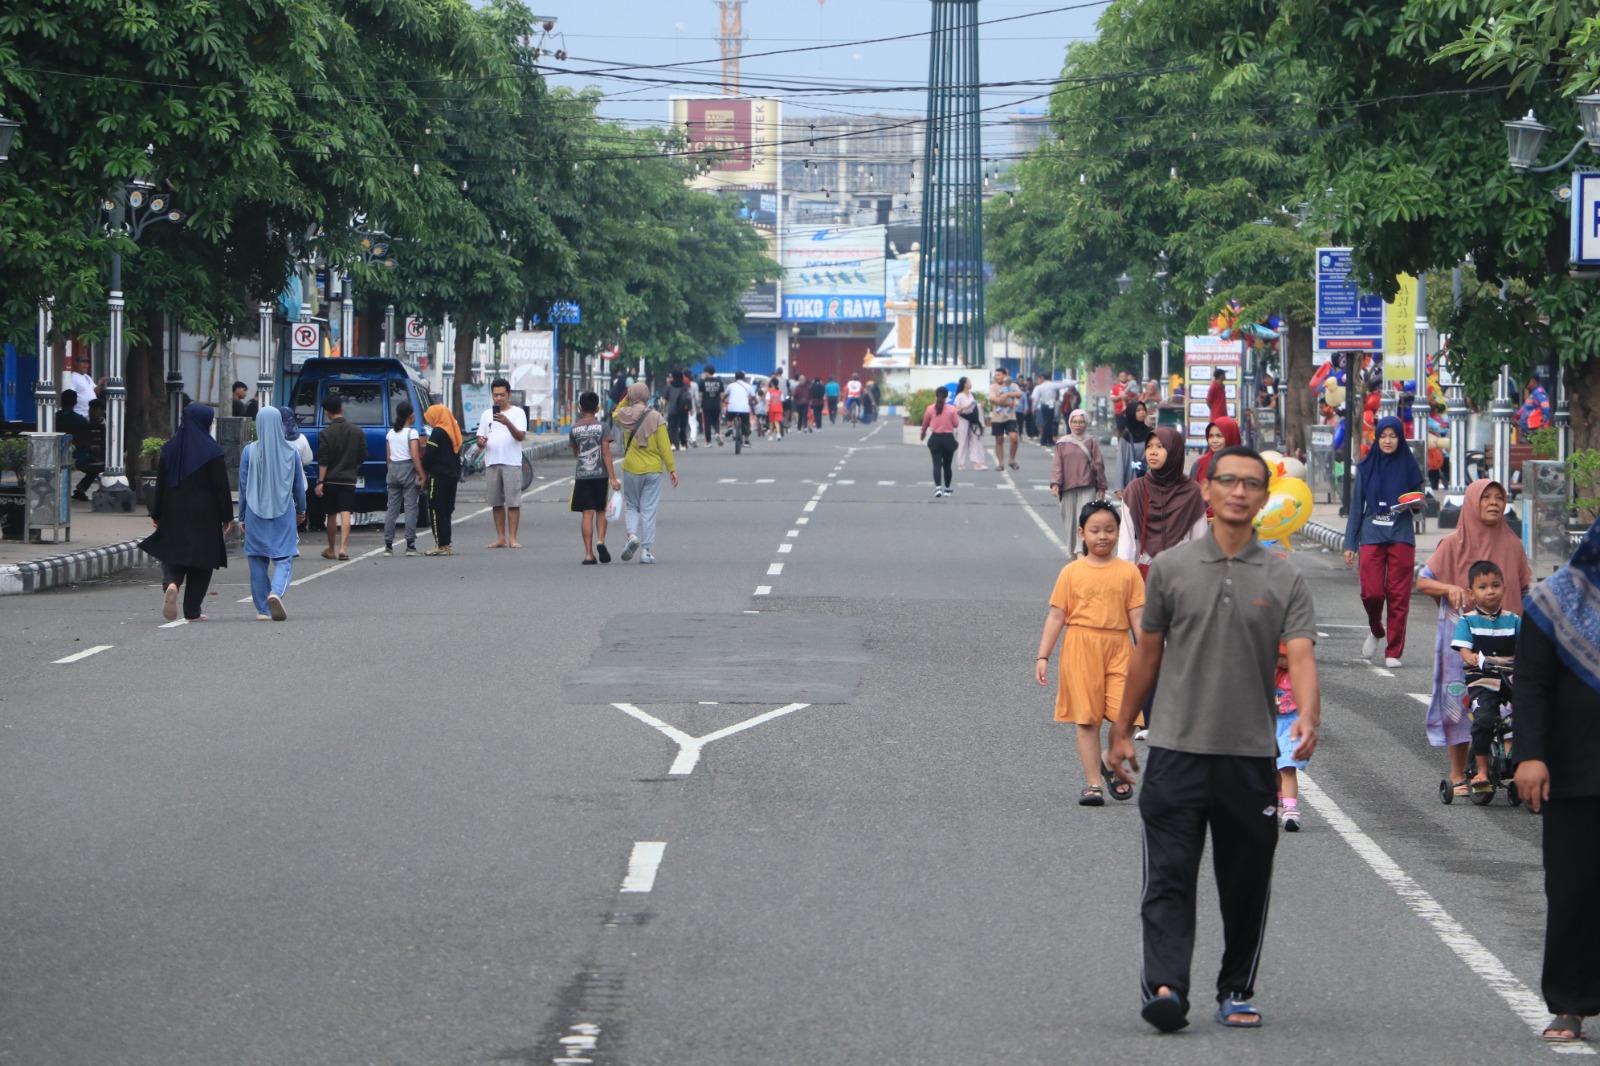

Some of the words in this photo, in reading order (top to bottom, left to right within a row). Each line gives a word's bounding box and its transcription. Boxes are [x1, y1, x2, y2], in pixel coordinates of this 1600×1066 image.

[755, 104, 765, 166] KRETEK
[785, 299, 824, 318] TOKO
[843, 299, 882, 318] RAYA
[511, 338, 550, 347] PARKIR
[510, 348, 550, 360] MOBIL
[1187, 353, 1212, 361] PROMO
[1213, 353, 1240, 361] SPESIAL
